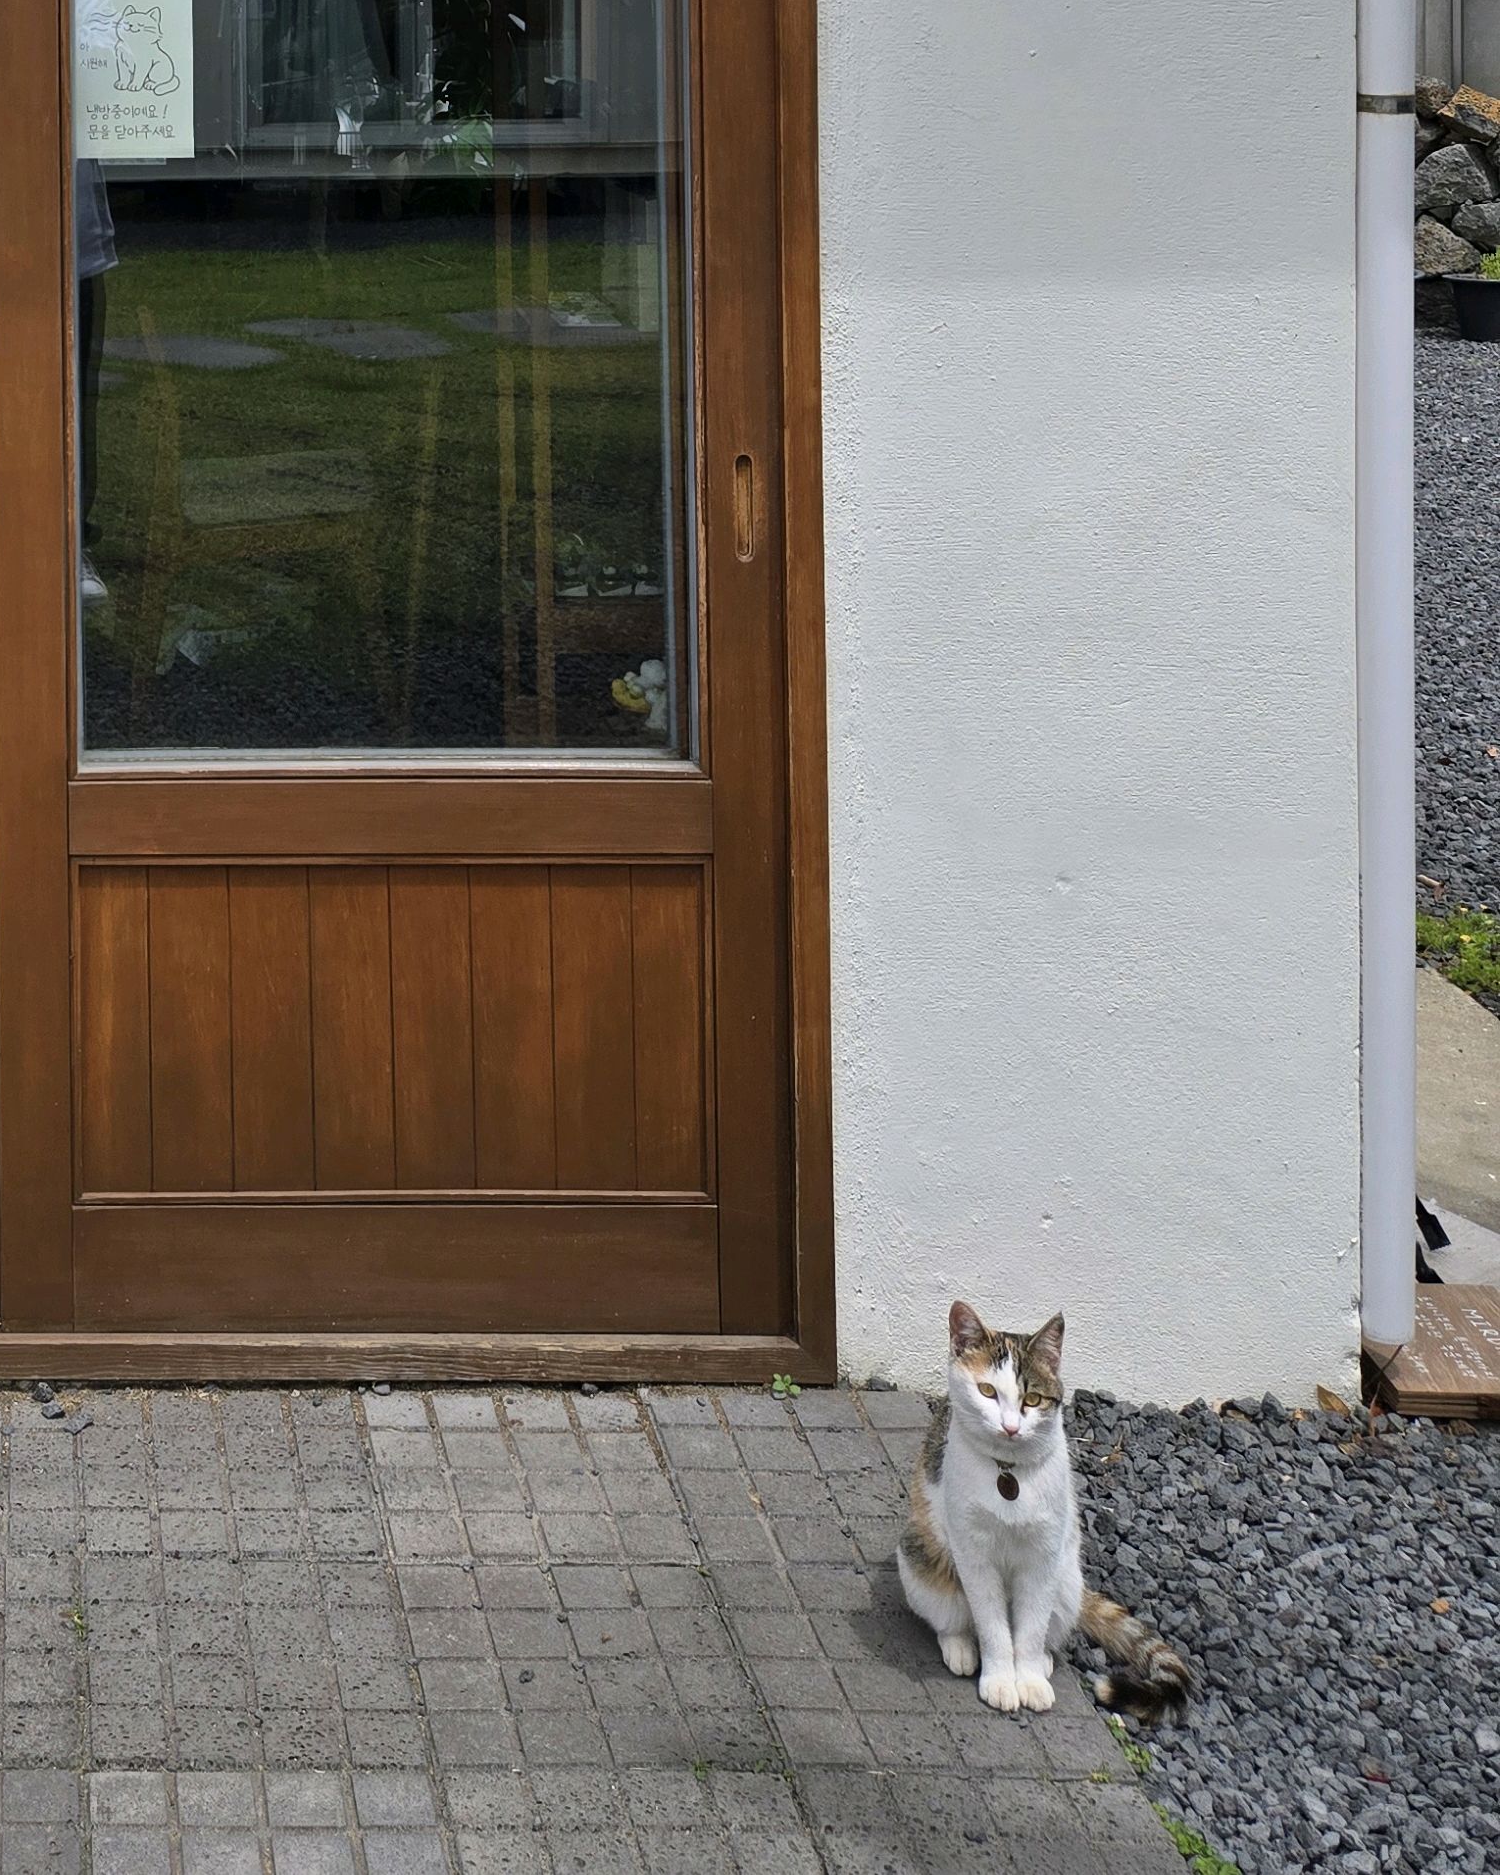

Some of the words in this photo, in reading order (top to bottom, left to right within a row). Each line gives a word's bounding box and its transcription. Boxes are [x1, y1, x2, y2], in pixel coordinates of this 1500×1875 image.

[79, 41, 90, 52] 아
[80, 57, 108, 70] 시원해
[87, 124, 111, 140] 문을
[114, 124, 176, 140] 닫아주세요
[1461, 1308, 1500, 1355] MIRD
